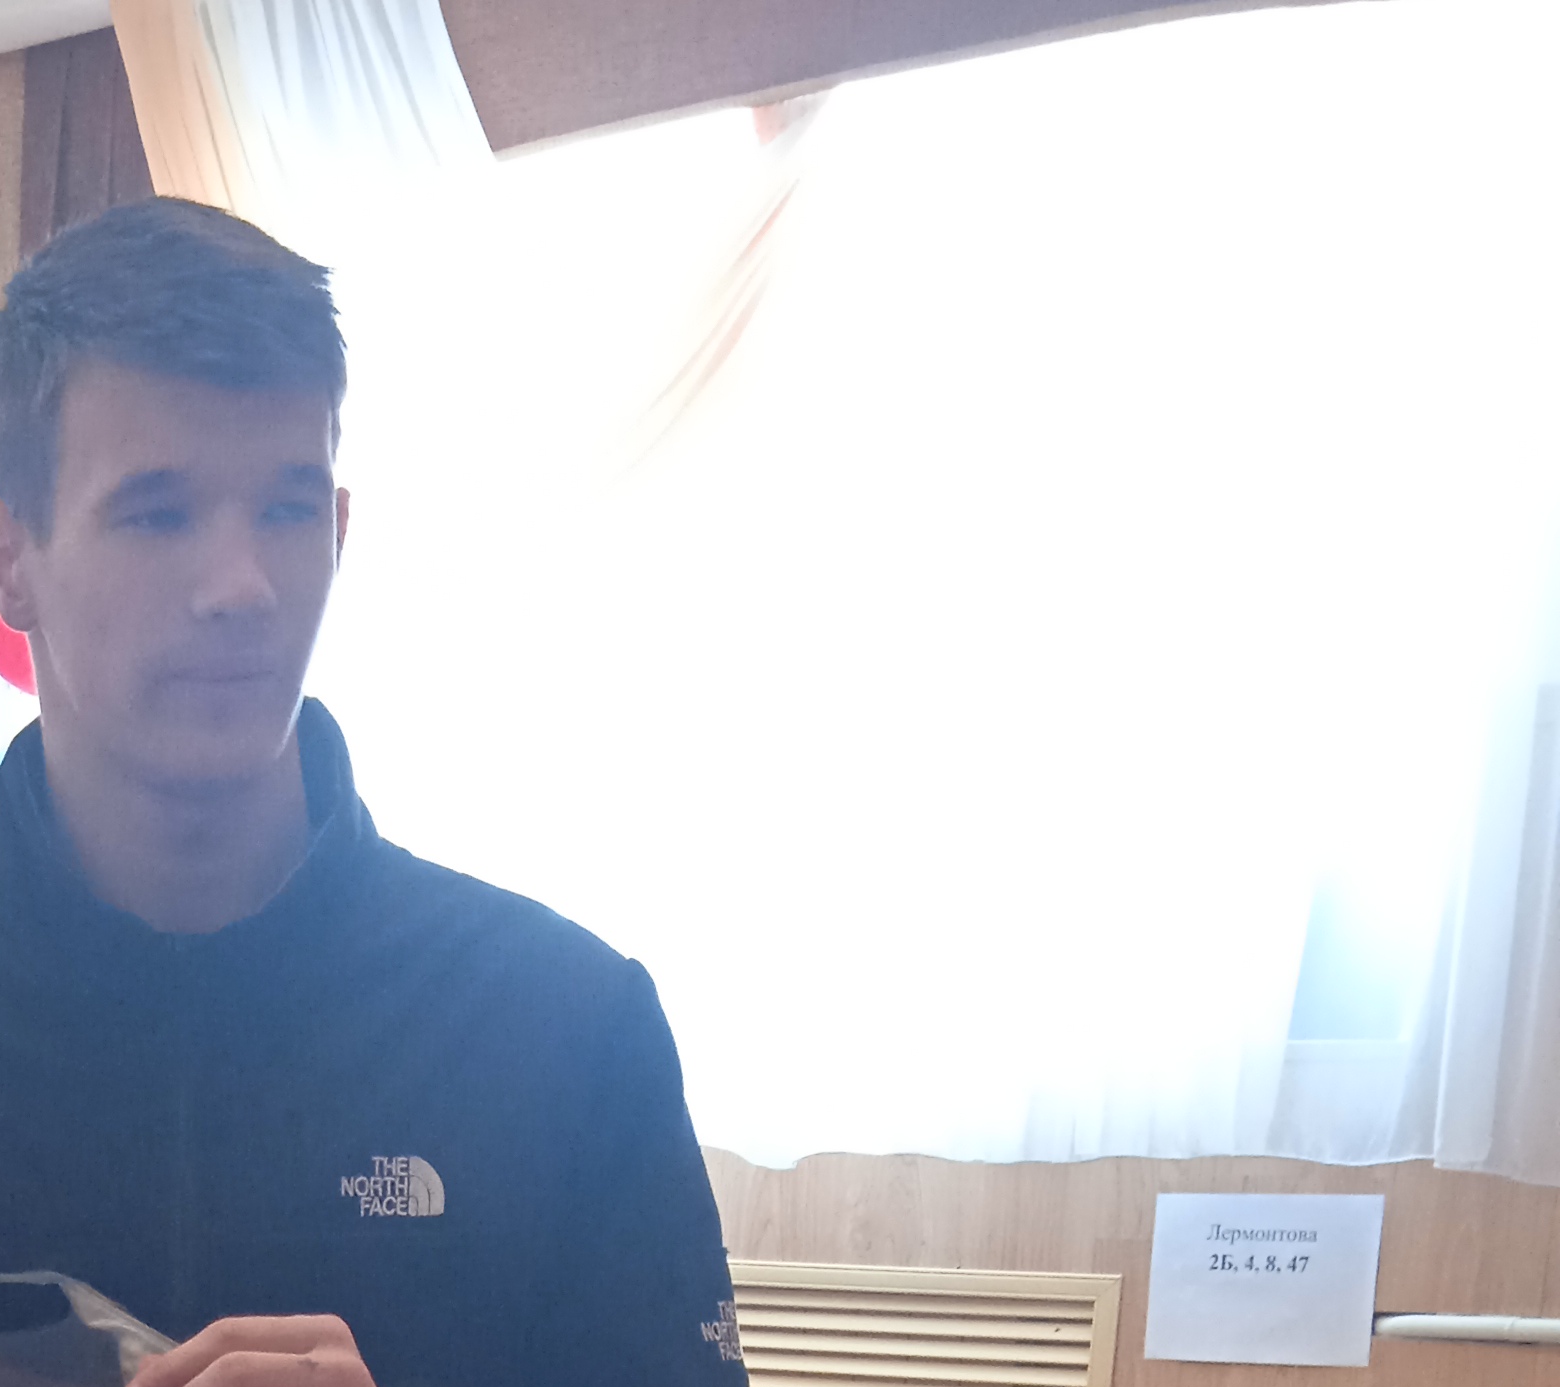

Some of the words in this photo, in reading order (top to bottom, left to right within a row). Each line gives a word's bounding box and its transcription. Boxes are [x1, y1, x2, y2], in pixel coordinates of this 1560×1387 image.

[371, 1156, 409, 1176] THE
[341, 1175, 409, 1197] NORTH
[360, 1196, 409, 1217] FACE
[1206, 1223, 1318, 1246] Лермонтова
[1287, 1255, 1310, 1273] 47
